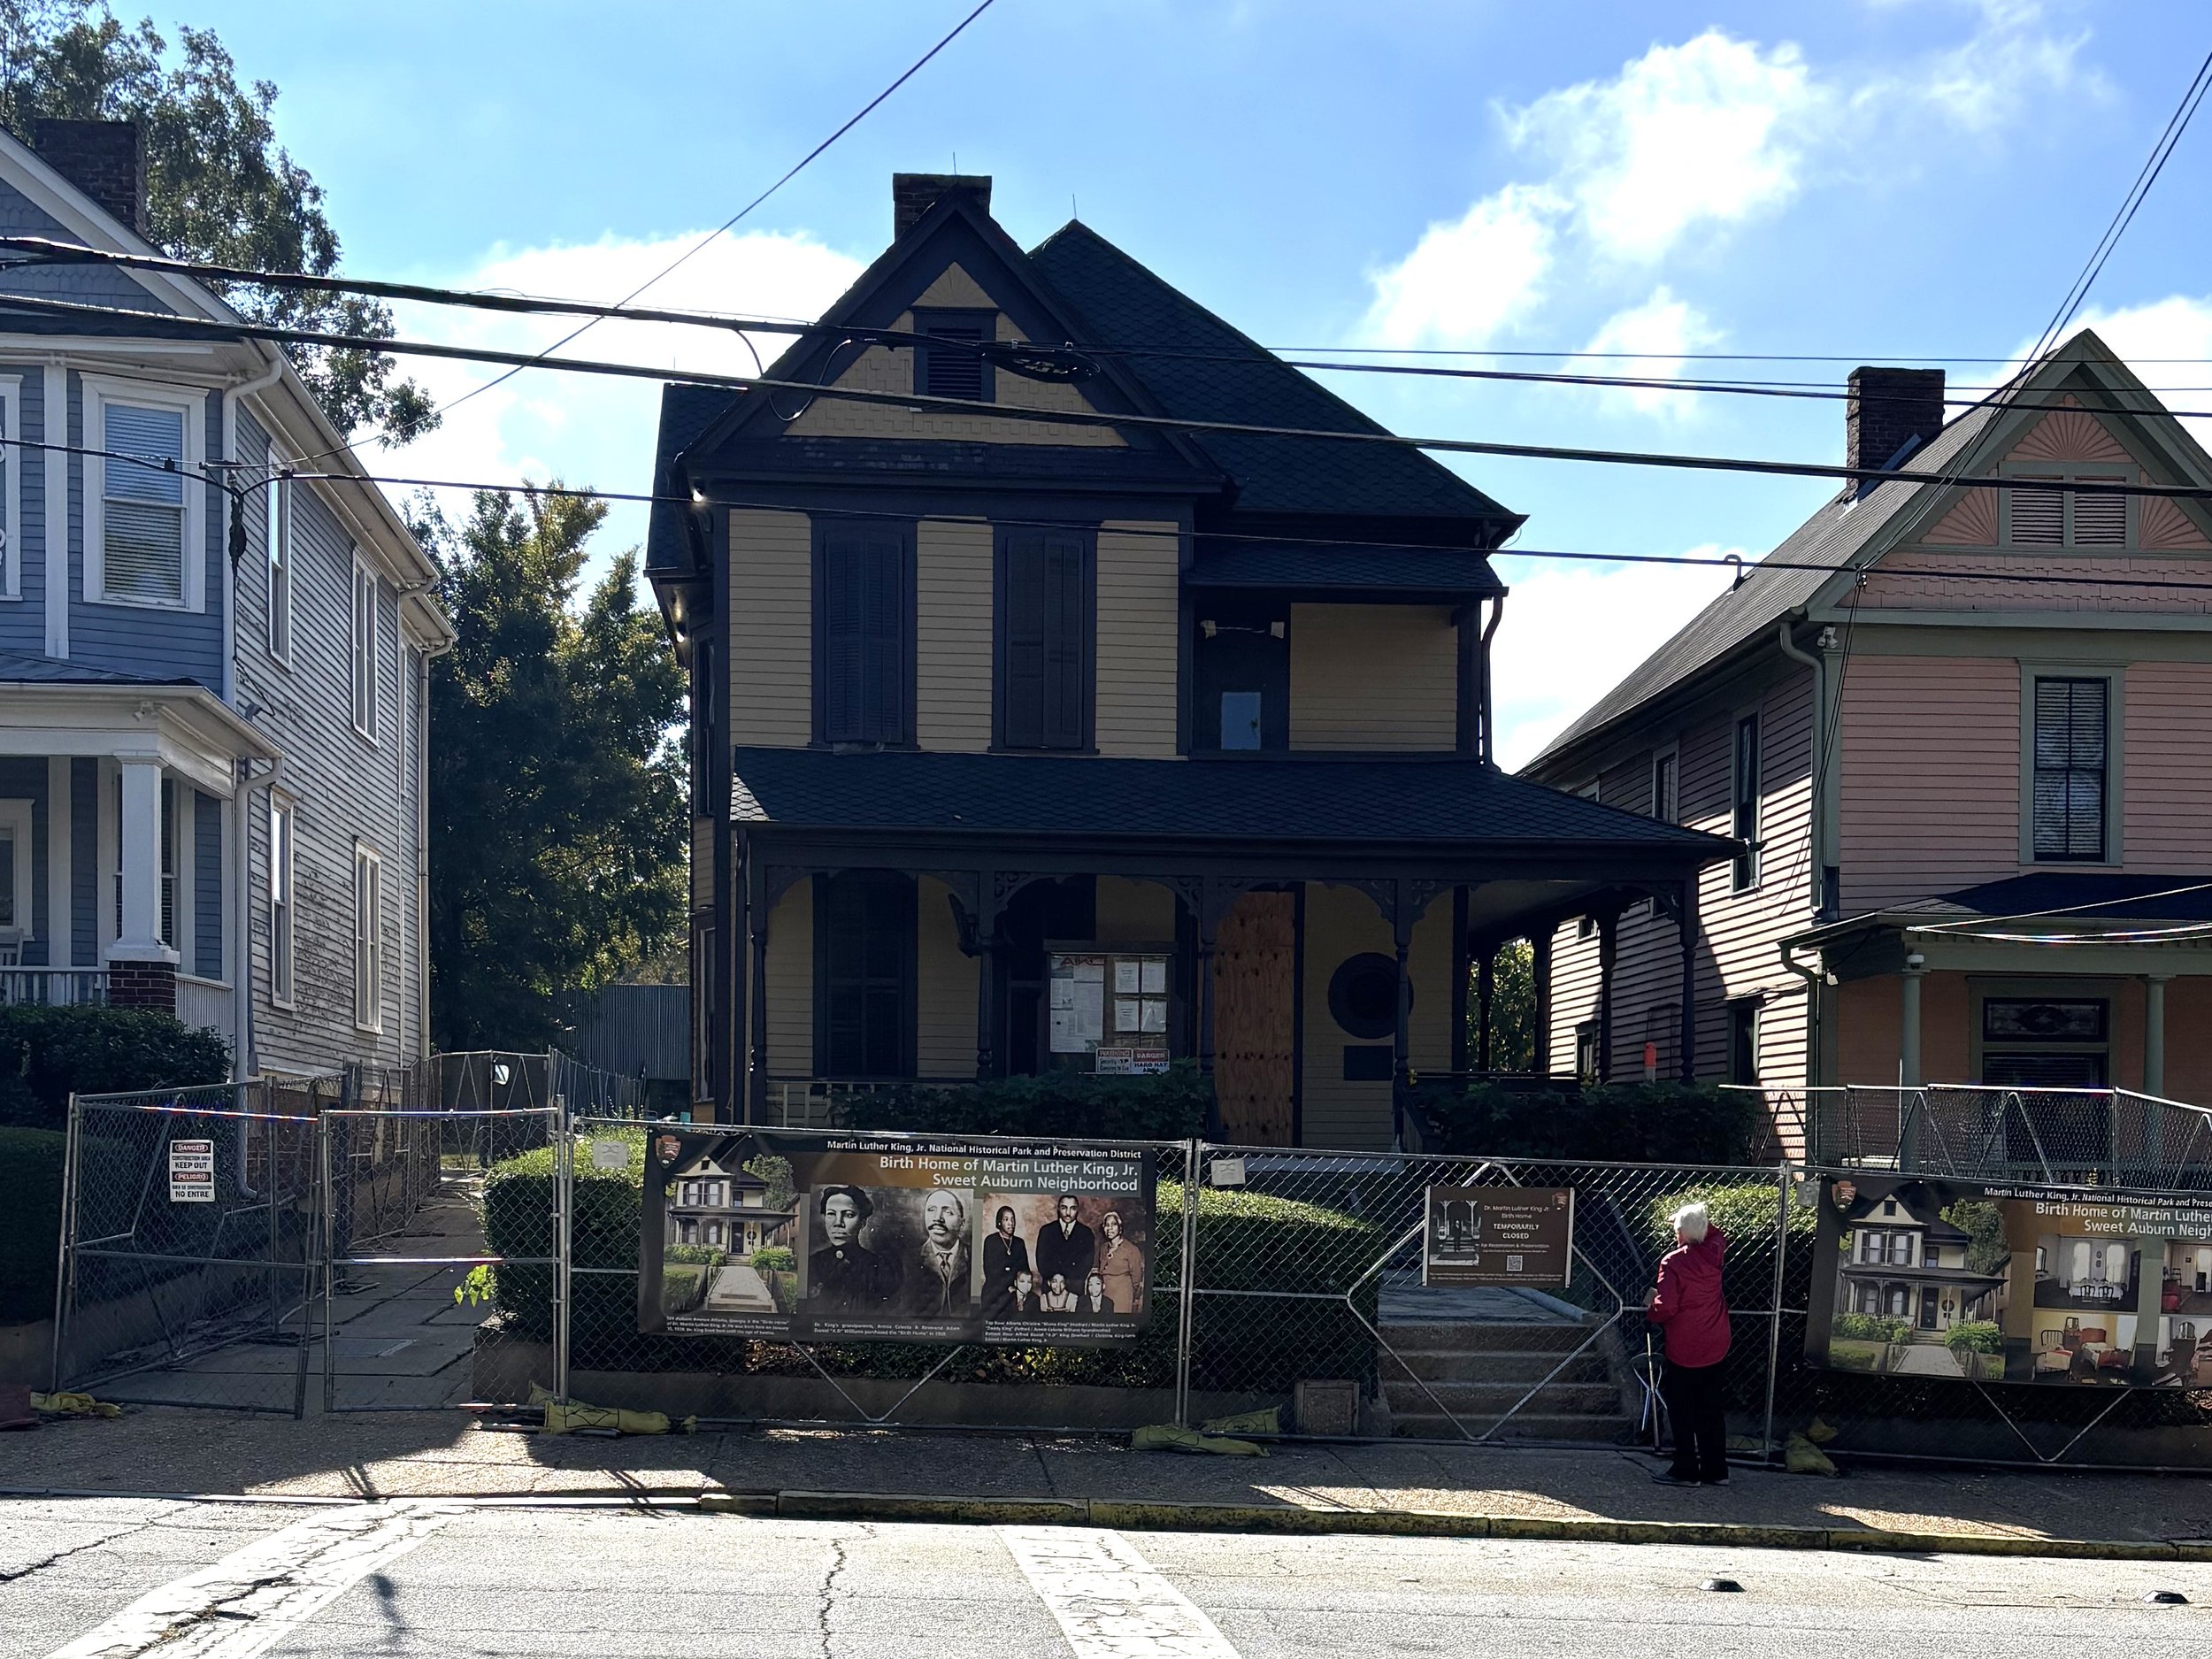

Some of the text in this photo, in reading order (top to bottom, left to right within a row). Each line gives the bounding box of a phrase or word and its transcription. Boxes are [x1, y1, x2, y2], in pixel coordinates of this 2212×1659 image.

[826, 1141, 857, 1149] Martin
[890, 1142, 914, 1154] King,
[928, 1144, 967, 1154] National
[969, 1146, 1010, 1156] Historical
[1012, 1147, 1033, 1156] Park
[1052, 1147, 1108, 1157] Preservation
[1110, 1149, 1142, 1159] District
[879, 1156, 1139, 1179] Birth Home of Martin Luther King, Jr.
[933, 1173, 1138, 1193] Sweet Auburn Neighborhood
[1984, 1187, 2012, 1196] Martin
[2014, 1187, 2045, 1199] Luther
[2070, 1193, 2081, 1202] Jr.
[2081, 1194, 2115, 1202] National
[2116, 1194, 2156, 1205] Historical
[2157, 1198, 2175, 1207] Park
[2176, 1198, 2191, 1207] and
[2035, 1202, 2212, 1223] Birth Home of Martin Luthe
[2084, 1219, 2124, 1233] Sweet
[2126, 1222, 2175, 1236] Auburn
